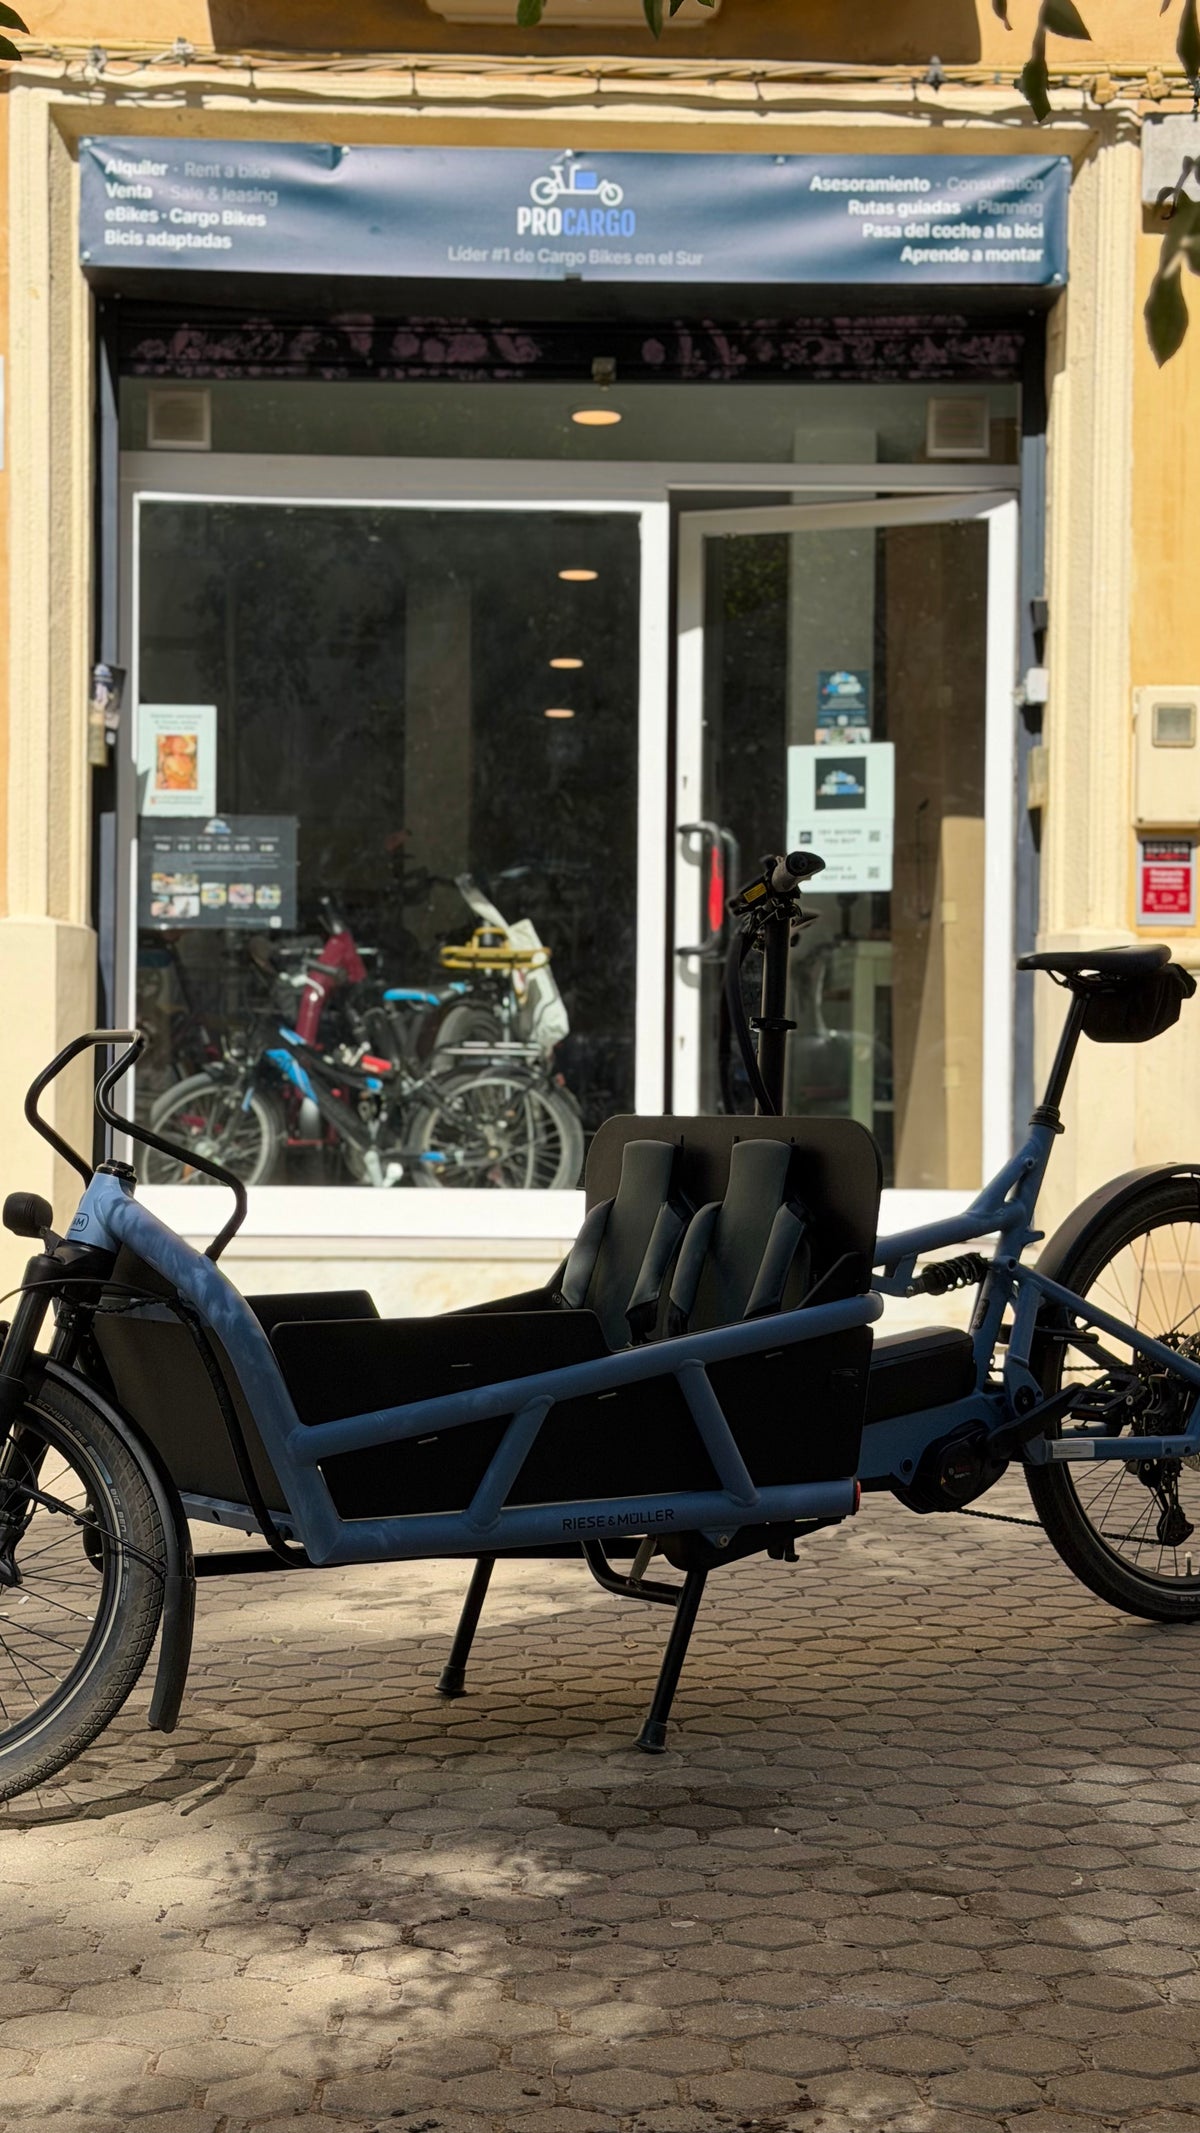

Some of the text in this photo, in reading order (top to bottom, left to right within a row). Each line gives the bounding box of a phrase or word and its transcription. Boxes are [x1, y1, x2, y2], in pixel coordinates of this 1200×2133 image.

[104, 158, 168, 178] Alquiler
[184, 160, 220, 178] Rent
[224, 165, 234, 178] a
[105, 181, 153, 199] Venta
[207, 186, 219, 200] &
[222, 187, 278, 207] leasing
[809, 176, 931, 192] Asesoramiento
[104, 206, 266, 228] eBikes Cargo Bikes
[848, 199, 1044, 218] Rutas guiadas Planning
[517, 207, 635, 236] PROCARGO
[862, 222, 1044, 239] Pasa del coche a la bici
[104, 229, 232, 250] Bicis adaptadas
[448, 245, 704, 267] Líder #1 de Cargo Bikes en el Sur
[900, 245, 1044, 266] Aprende a montar
[562, 1515, 606, 1531] RIESE
[617, 1508, 675, 1526] MÜLLER
